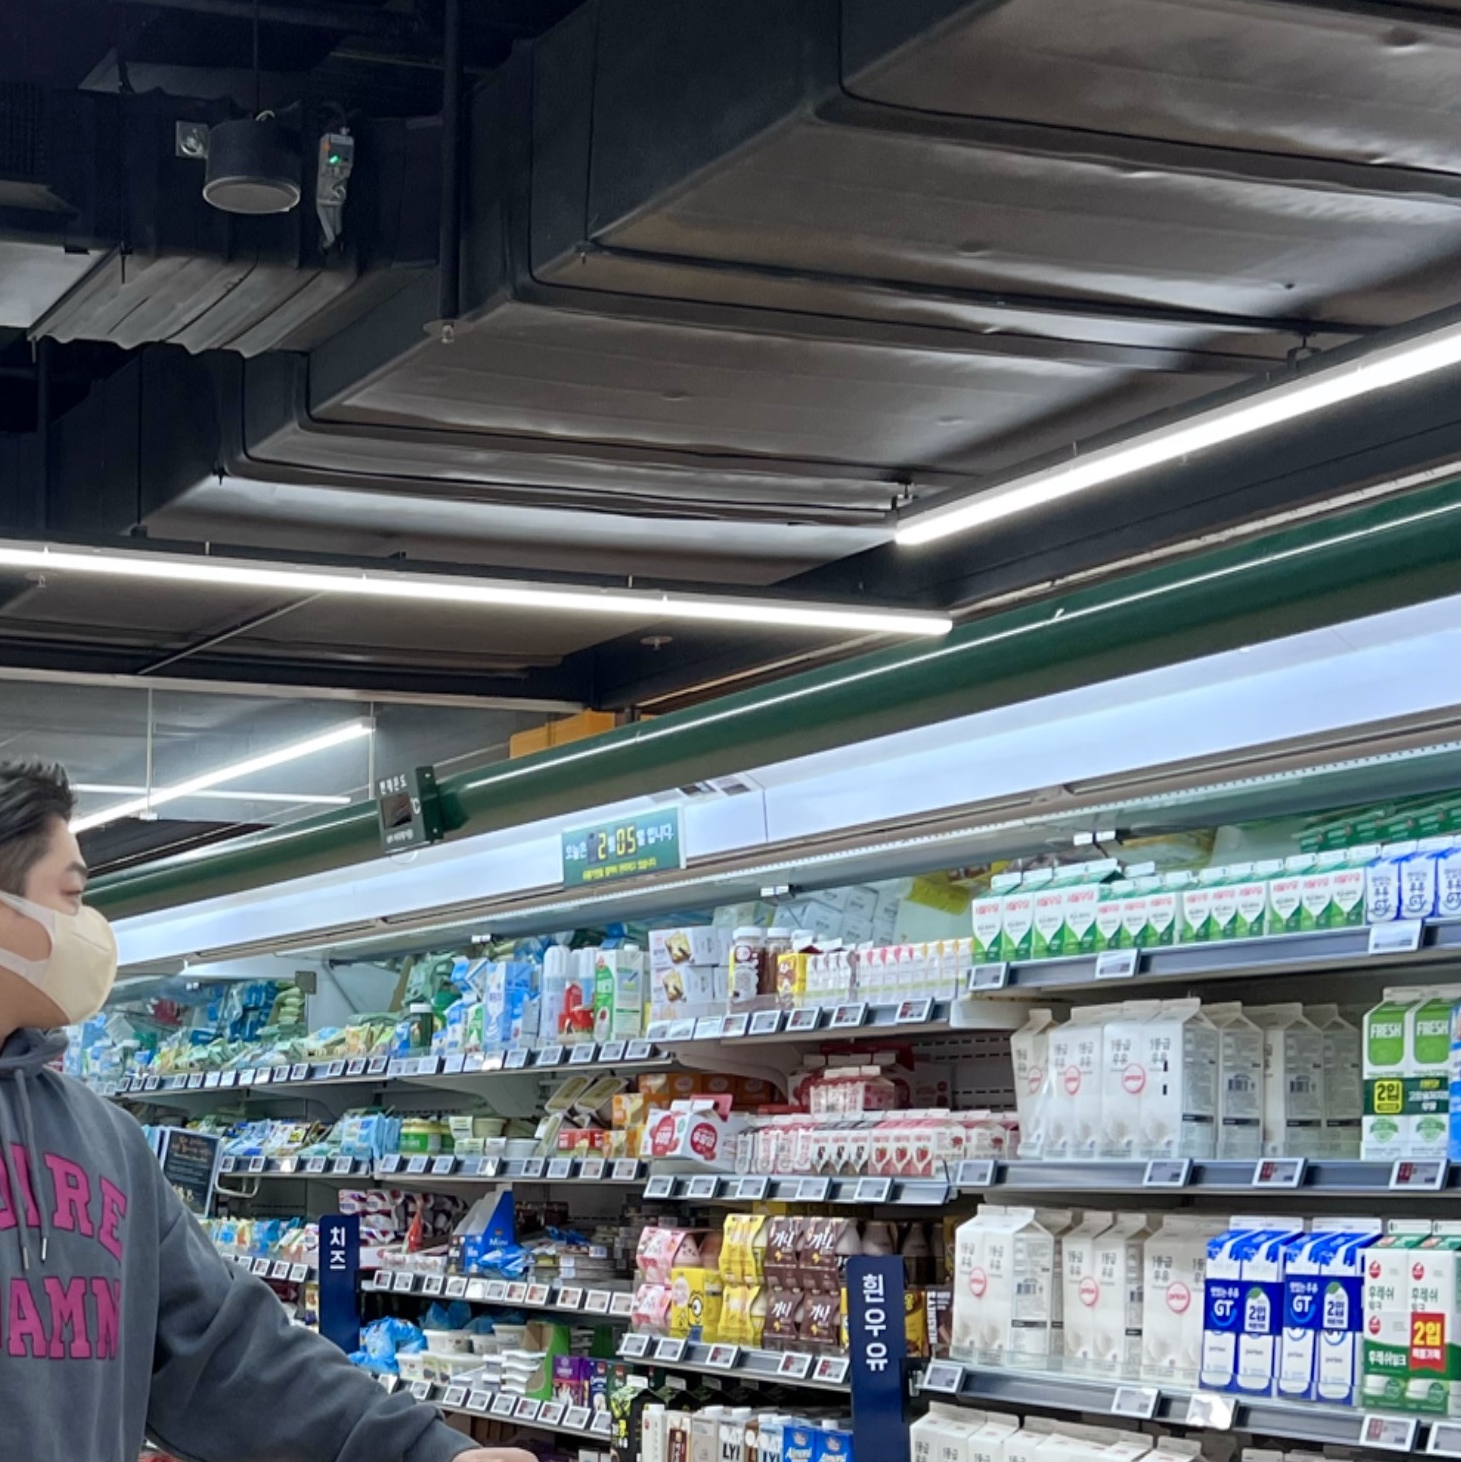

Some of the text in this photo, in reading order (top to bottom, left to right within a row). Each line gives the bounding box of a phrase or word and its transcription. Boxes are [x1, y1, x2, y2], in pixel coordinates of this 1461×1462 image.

[1371, 1022, 1402, 1039] FRESH
[1417, 1020, 1448, 1036] FRESH
[329, 1226, 347, 1270] 치즈
[1292, 1296, 1312, 1312] GT
[1412, 1288, 1438, 1303] 후레쉬
[1214, 1301, 1234, 1316] GT
[863, 1273, 888, 1372] 흰우유
[1413, 1321, 1441, 1346] 2입
[723, 1443, 740, 1461] LY!
